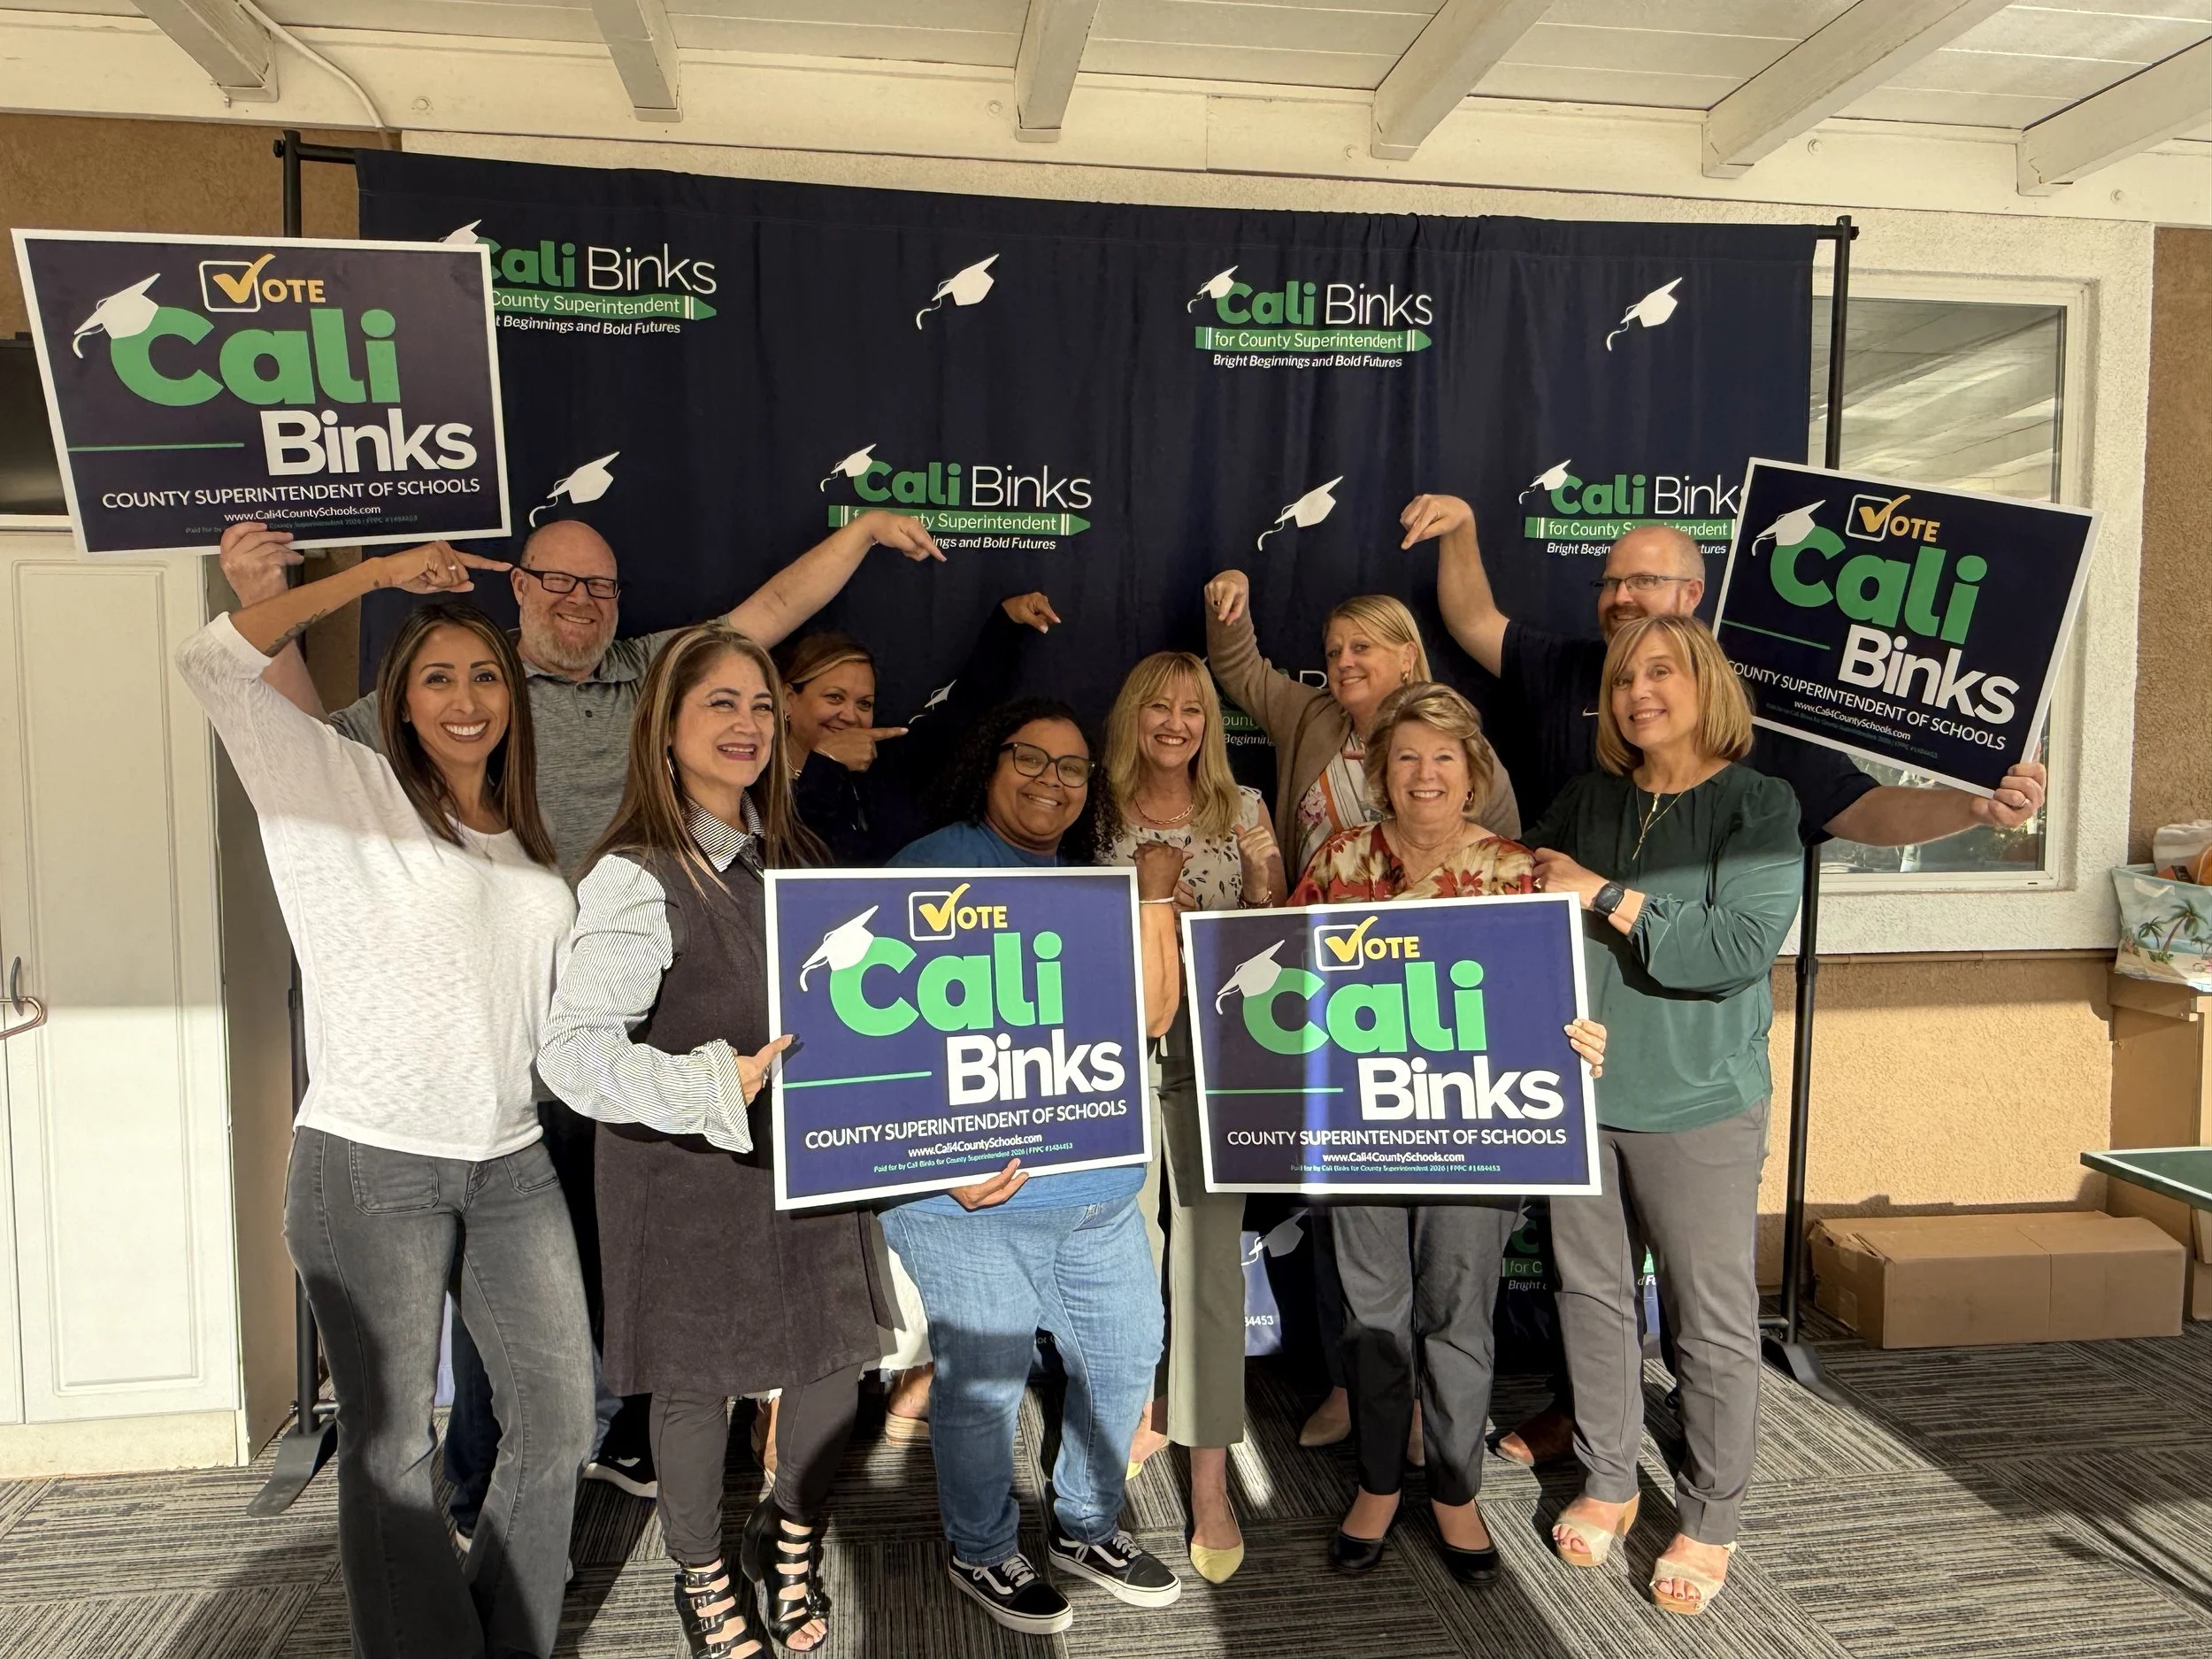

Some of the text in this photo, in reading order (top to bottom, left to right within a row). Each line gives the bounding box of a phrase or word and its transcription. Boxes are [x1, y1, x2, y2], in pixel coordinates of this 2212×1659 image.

[588, 243, 717, 295] Binks
[493, 290, 680, 317] County Superintendent
[1216, 280, 1432, 326] Cali Binks
[503, 316, 574, 334] Beginnings
[576, 319, 600, 333] and
[603, 322, 633, 335] Bold
[634, 321, 680, 334] Futures
[1215, 333, 1403, 349] for County Superintendent
[111, 306, 401, 406] Cali
[1213, 355, 1402, 369] Bright Beginnings and Bold Futures
[260, 408, 477, 476] Binks
[102, 478, 480, 509] COUNTY SUPERINTENDENT OF SCHOOLS
[853, 460, 1092, 509] Cali Binks
[1550, 474, 1744, 514] Cali Bink
[224, 506, 381, 522] www.Cali4CountySchools.com
[937, 513, 1056, 531] Superintendent
[958, 538, 980, 549] and
[983, 537, 1010, 549] Bold
[1011, 537, 1056, 549] Futures
[1548, 522, 1568, 535] for
[1571, 522, 1619, 538] County
[1547, 542, 1578, 556] Bright
[1701, 543, 1726, 554] tures
[1770, 525, 1987, 645] Cali
[1838, 624, 2020, 725] Binks
[1780, 675, 1907, 721] SUPERINTENDENT
[1907, 710, 1930, 727] OF
[1930, 718, 2007, 750] SCHOOLS
[829, 931, 1064, 1037] Cali
[1242, 959, 1487, 1055] Cali
[946, 1028, 1125, 1107] Binks
[1357, 1056, 1564, 1121] Binks
[805, 1099, 1127, 1149] COUNTY SUPERINTENDENT OF SCHOOLS
[1227, 1128, 1567, 1146] COUNTY SUPERINTENDENT OF SCHOOLS
[908, 1133, 1043, 1158] www.Cali4CountySchools.com
[1322, 1151, 1465, 1164] www.Cali4CountySchools.com
[873, 1164, 887, 1173] Paid
[1509, 1260, 1529, 1273] for
